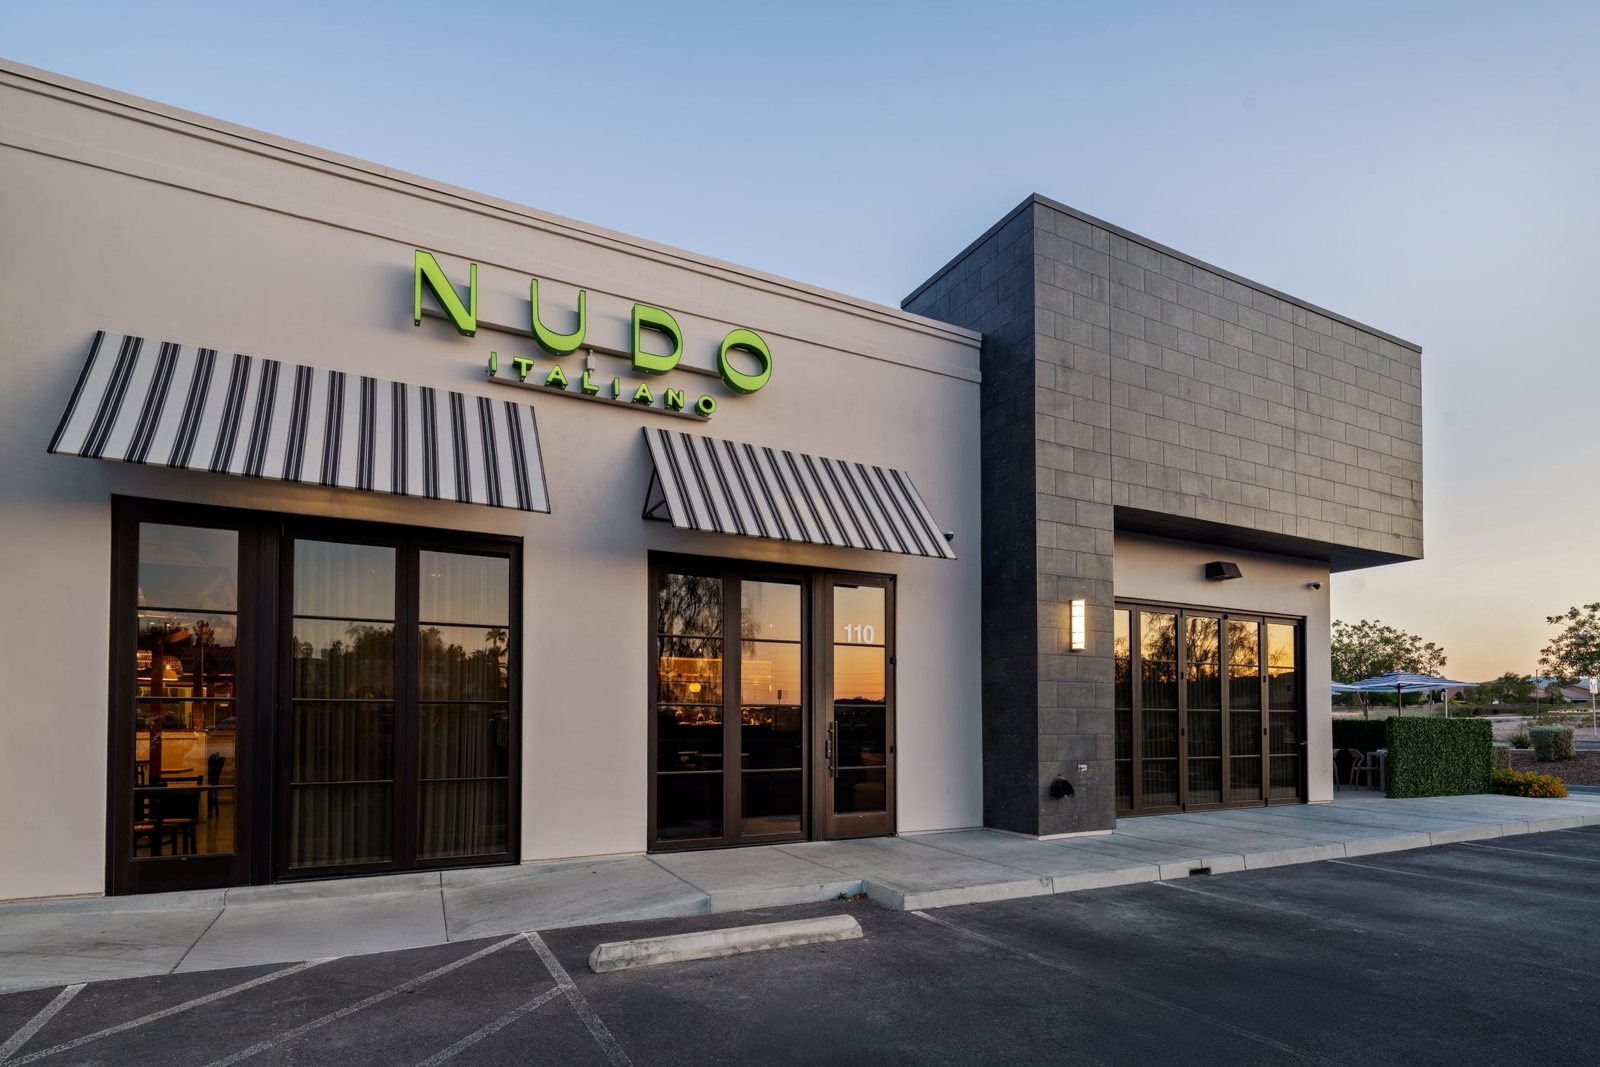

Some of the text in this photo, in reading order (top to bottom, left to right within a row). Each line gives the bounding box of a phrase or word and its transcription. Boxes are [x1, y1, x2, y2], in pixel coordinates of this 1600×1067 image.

[414, 249, 773, 394] NUDO
[489, 351, 717, 417] ITALIANO
[844, 623, 875, 644] 110
